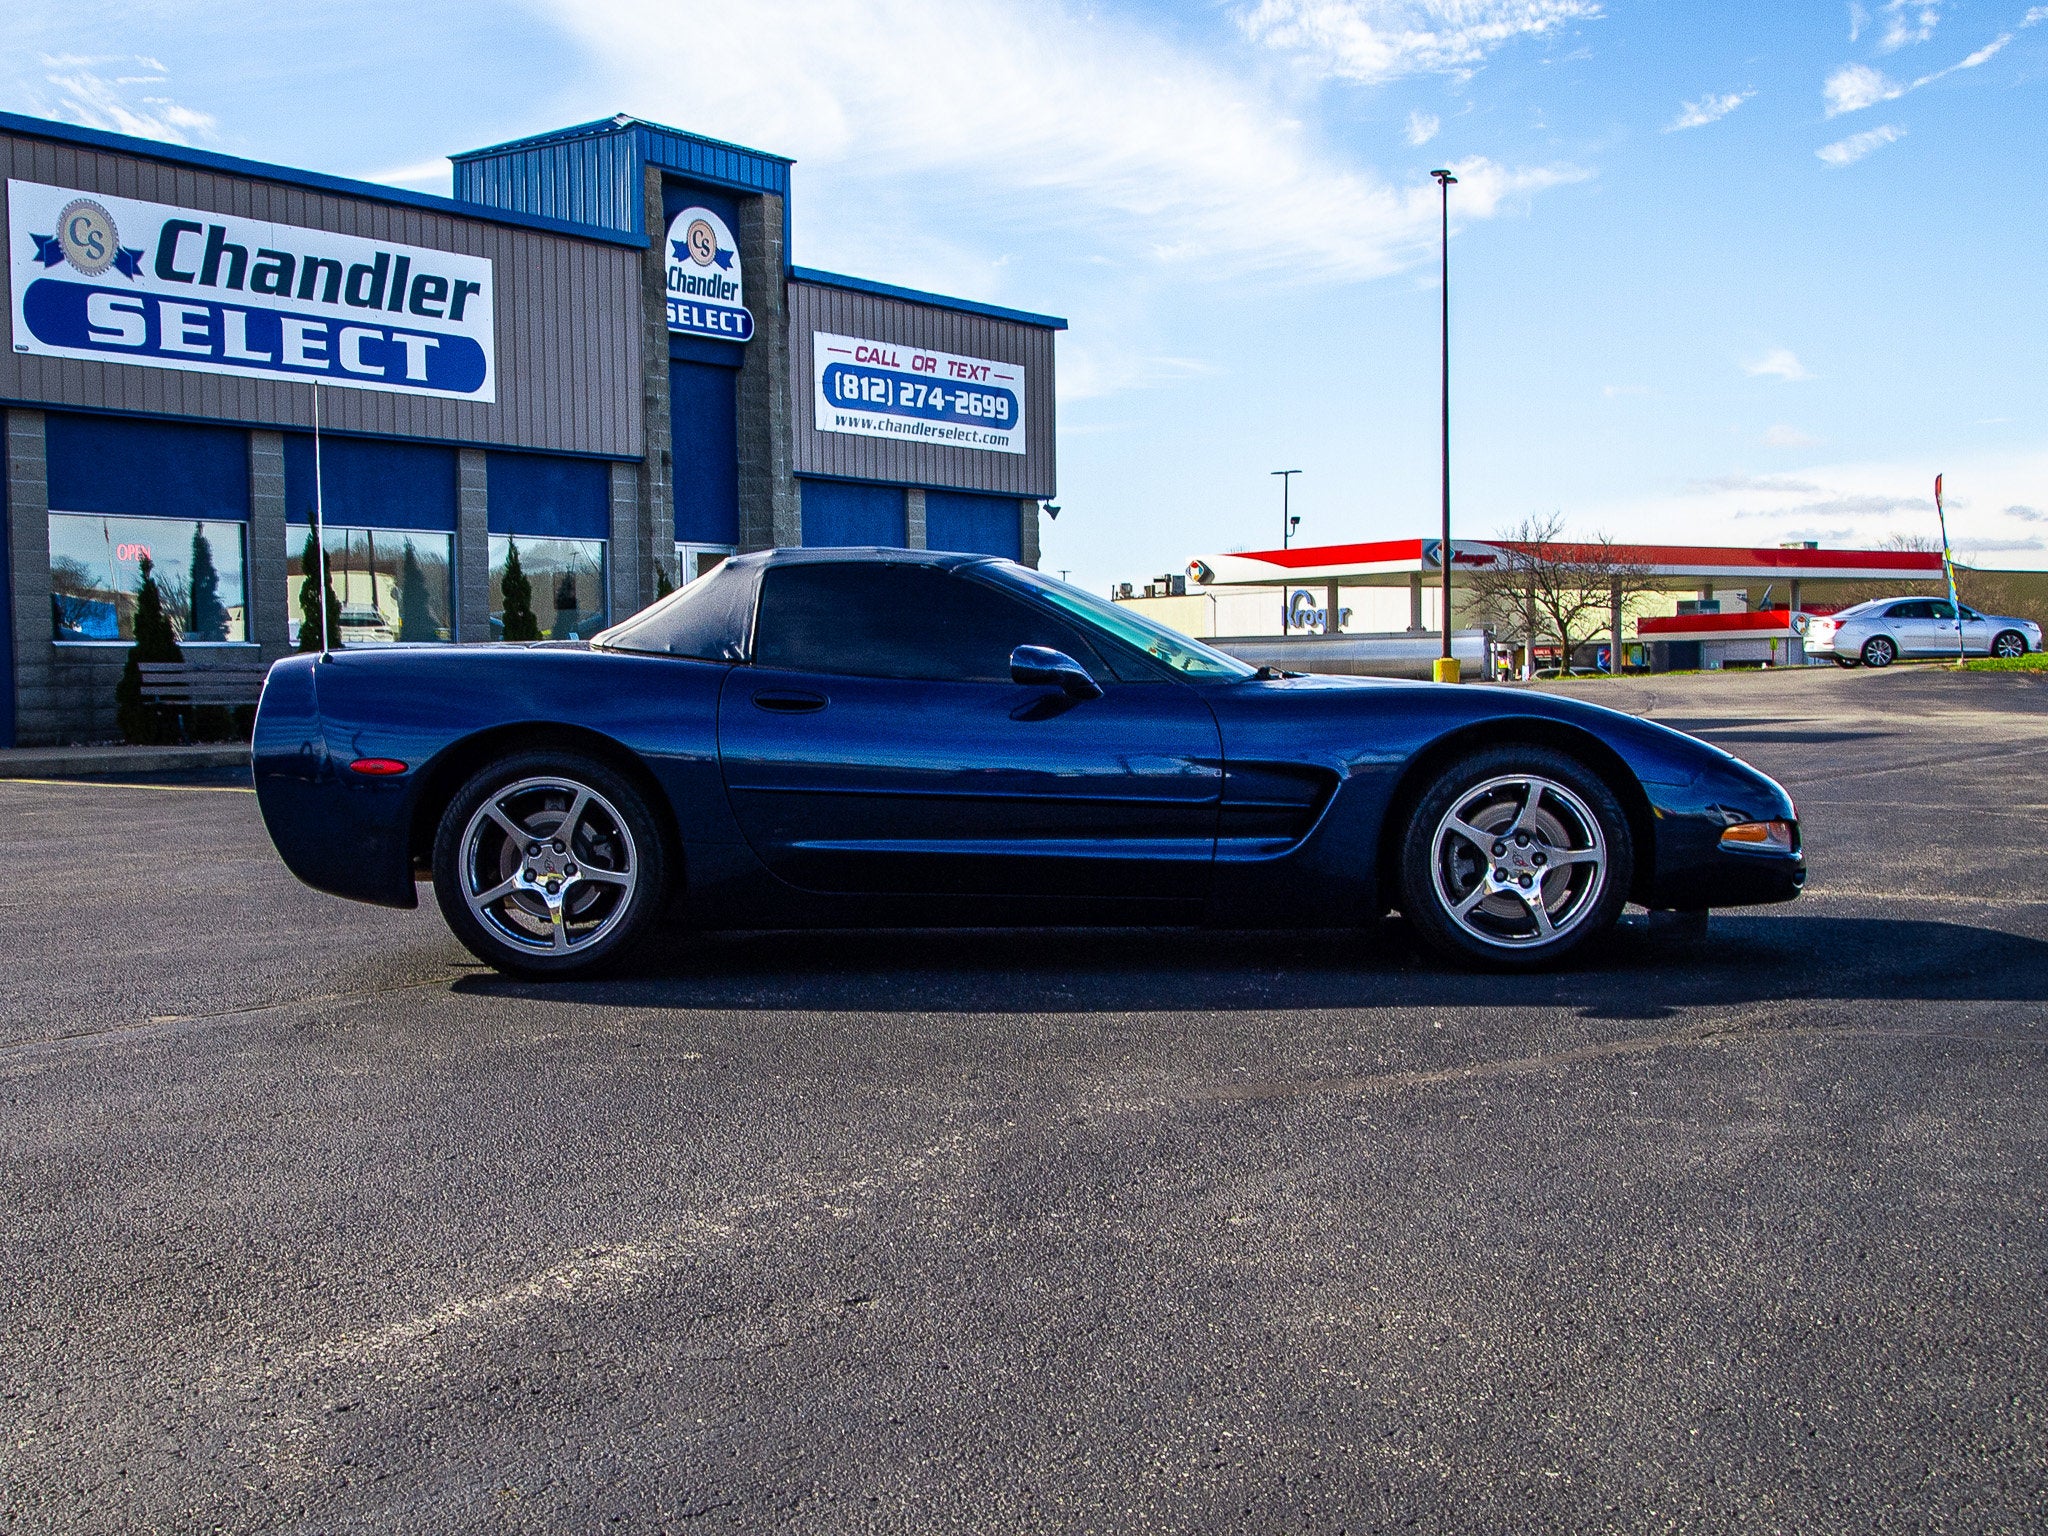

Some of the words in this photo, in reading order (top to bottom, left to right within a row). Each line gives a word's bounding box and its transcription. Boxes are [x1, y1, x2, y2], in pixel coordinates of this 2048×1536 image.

[155, 219, 480, 321] Chandler
[668, 266, 739, 301] Chandler
[666, 302, 746, 333] SELECT
[87, 292, 440, 381] SELECT
[855, 346, 900, 368] CALL
[911, 355, 937, 373] OR
[947, 361, 991, 382] TEXT
[834, 371, 894, 407] (812)
[899, 381, 1009, 420] 274-2699
[835, 414, 1010, 447] www.chandlerselect.com
[116, 543, 152, 562] OPEN
[1281, 589, 1350, 635] Krogr
